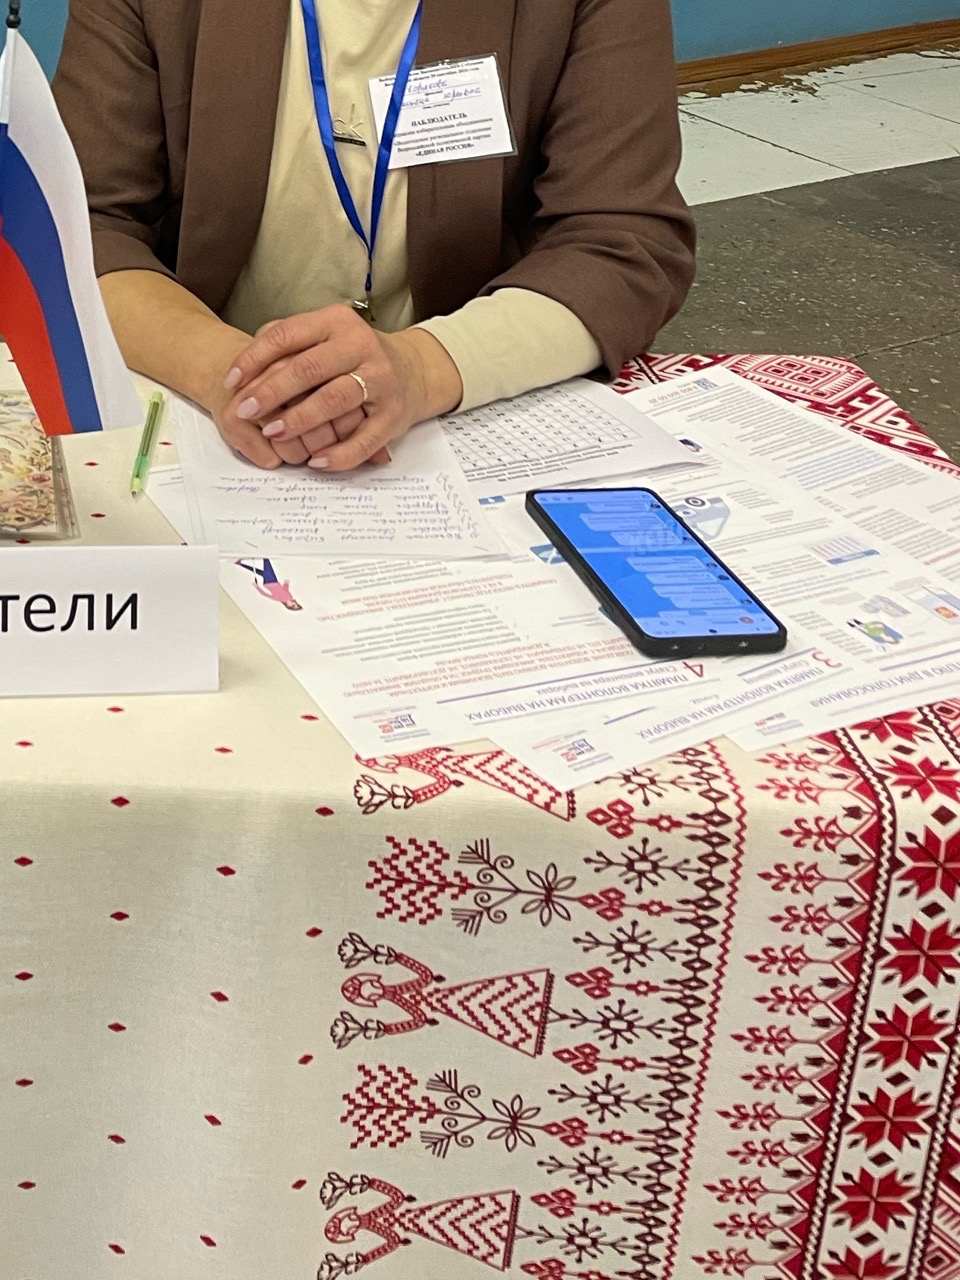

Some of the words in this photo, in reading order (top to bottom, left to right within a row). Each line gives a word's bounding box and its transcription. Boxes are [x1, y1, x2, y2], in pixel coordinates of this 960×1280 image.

[411, 112, 468, 127] НАБЛЮДАТЕЛЬ
[415, 147, 445, 157] «ЕДИНАЯ
[682, 661, 704, 679] 4
[629, 673, 688, 691] ПАМЯТКА
[775, 668, 823, 692] ПАМЯТКА
[526, 699, 547, 710] НА
[548, 683, 629, 708] ВОЛОНТЕРАМ
[704, 683, 776, 716] ВОЛОНТЕРАМ
[464, 703, 524, 721] ВЫБОРАХ
